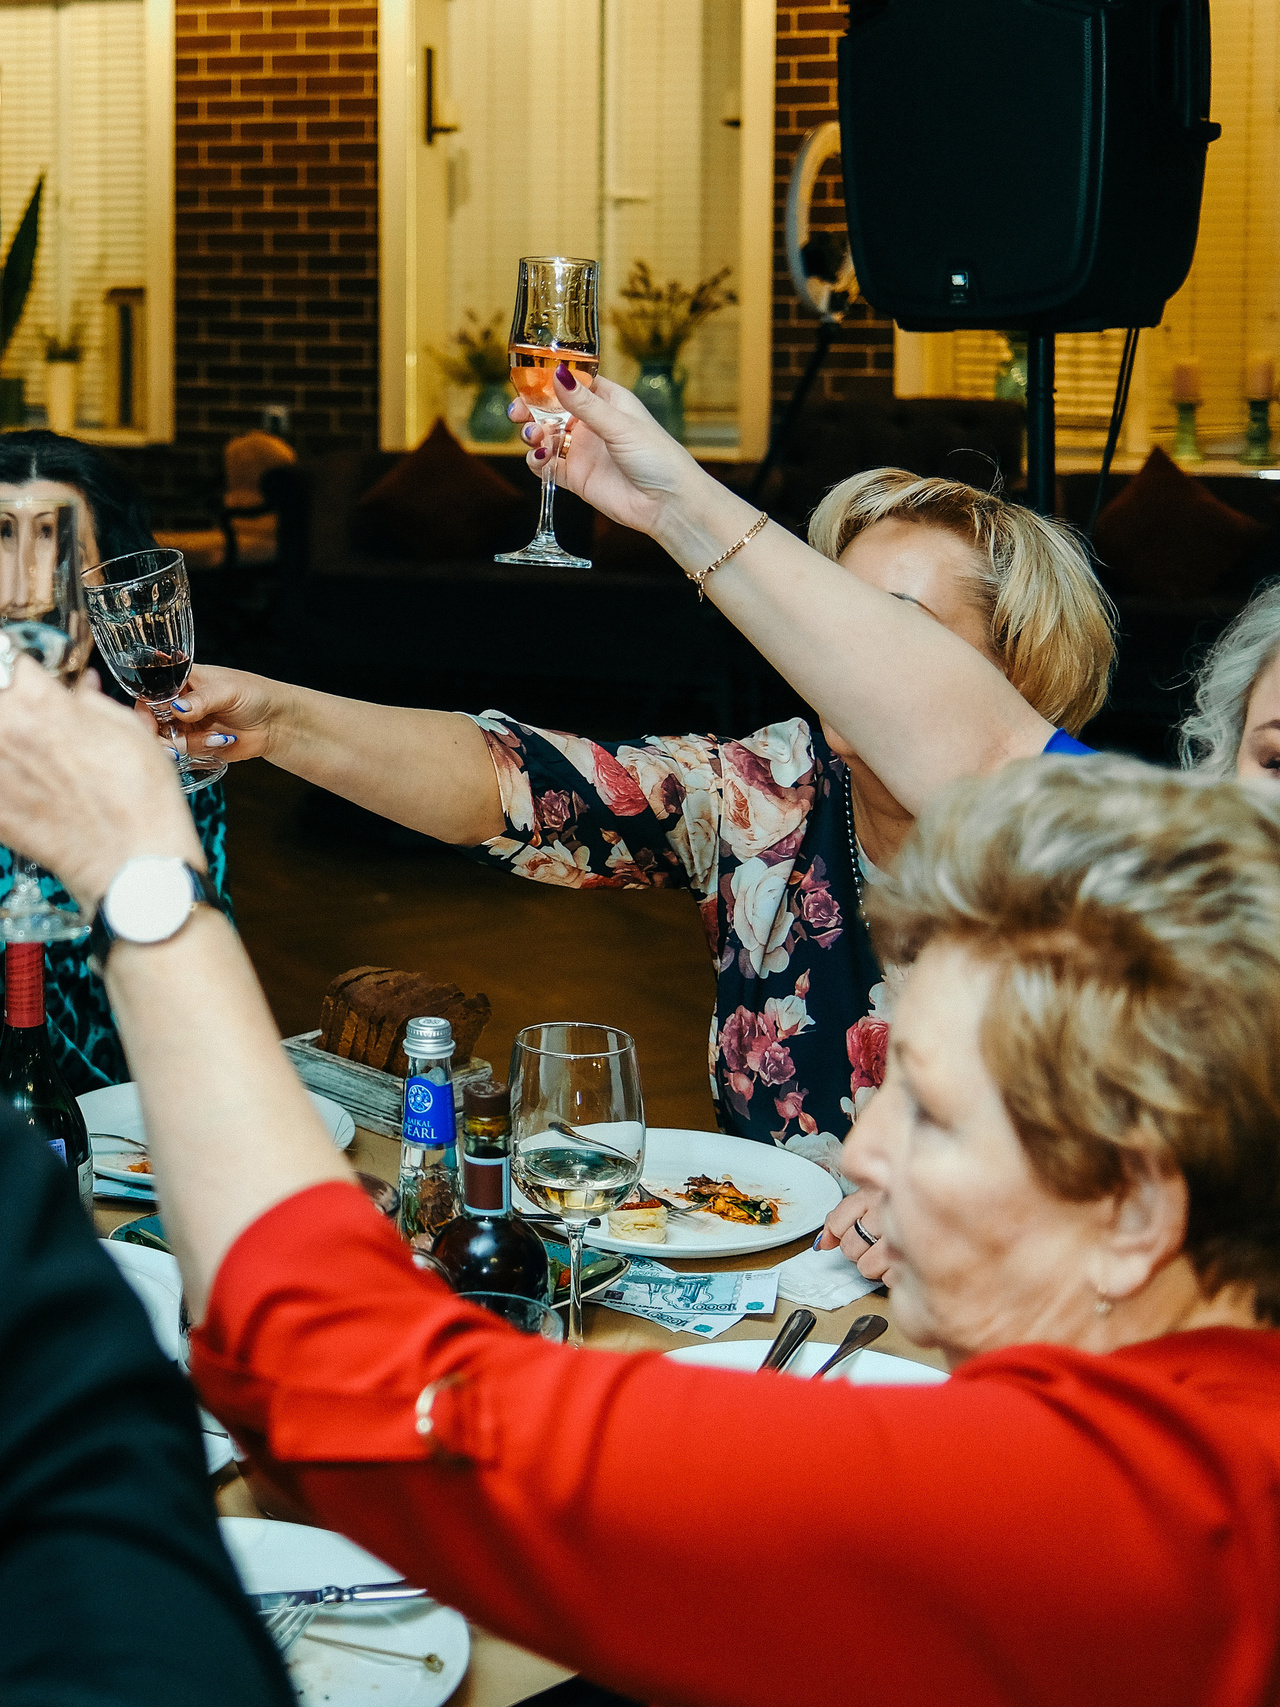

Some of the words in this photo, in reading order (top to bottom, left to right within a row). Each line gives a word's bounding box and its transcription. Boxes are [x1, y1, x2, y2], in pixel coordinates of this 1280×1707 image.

[407, 1117, 431, 1127] BAIKAL
[404, 1122, 437, 1139] PEARL
[692, 1303, 737, 1312] 1000
